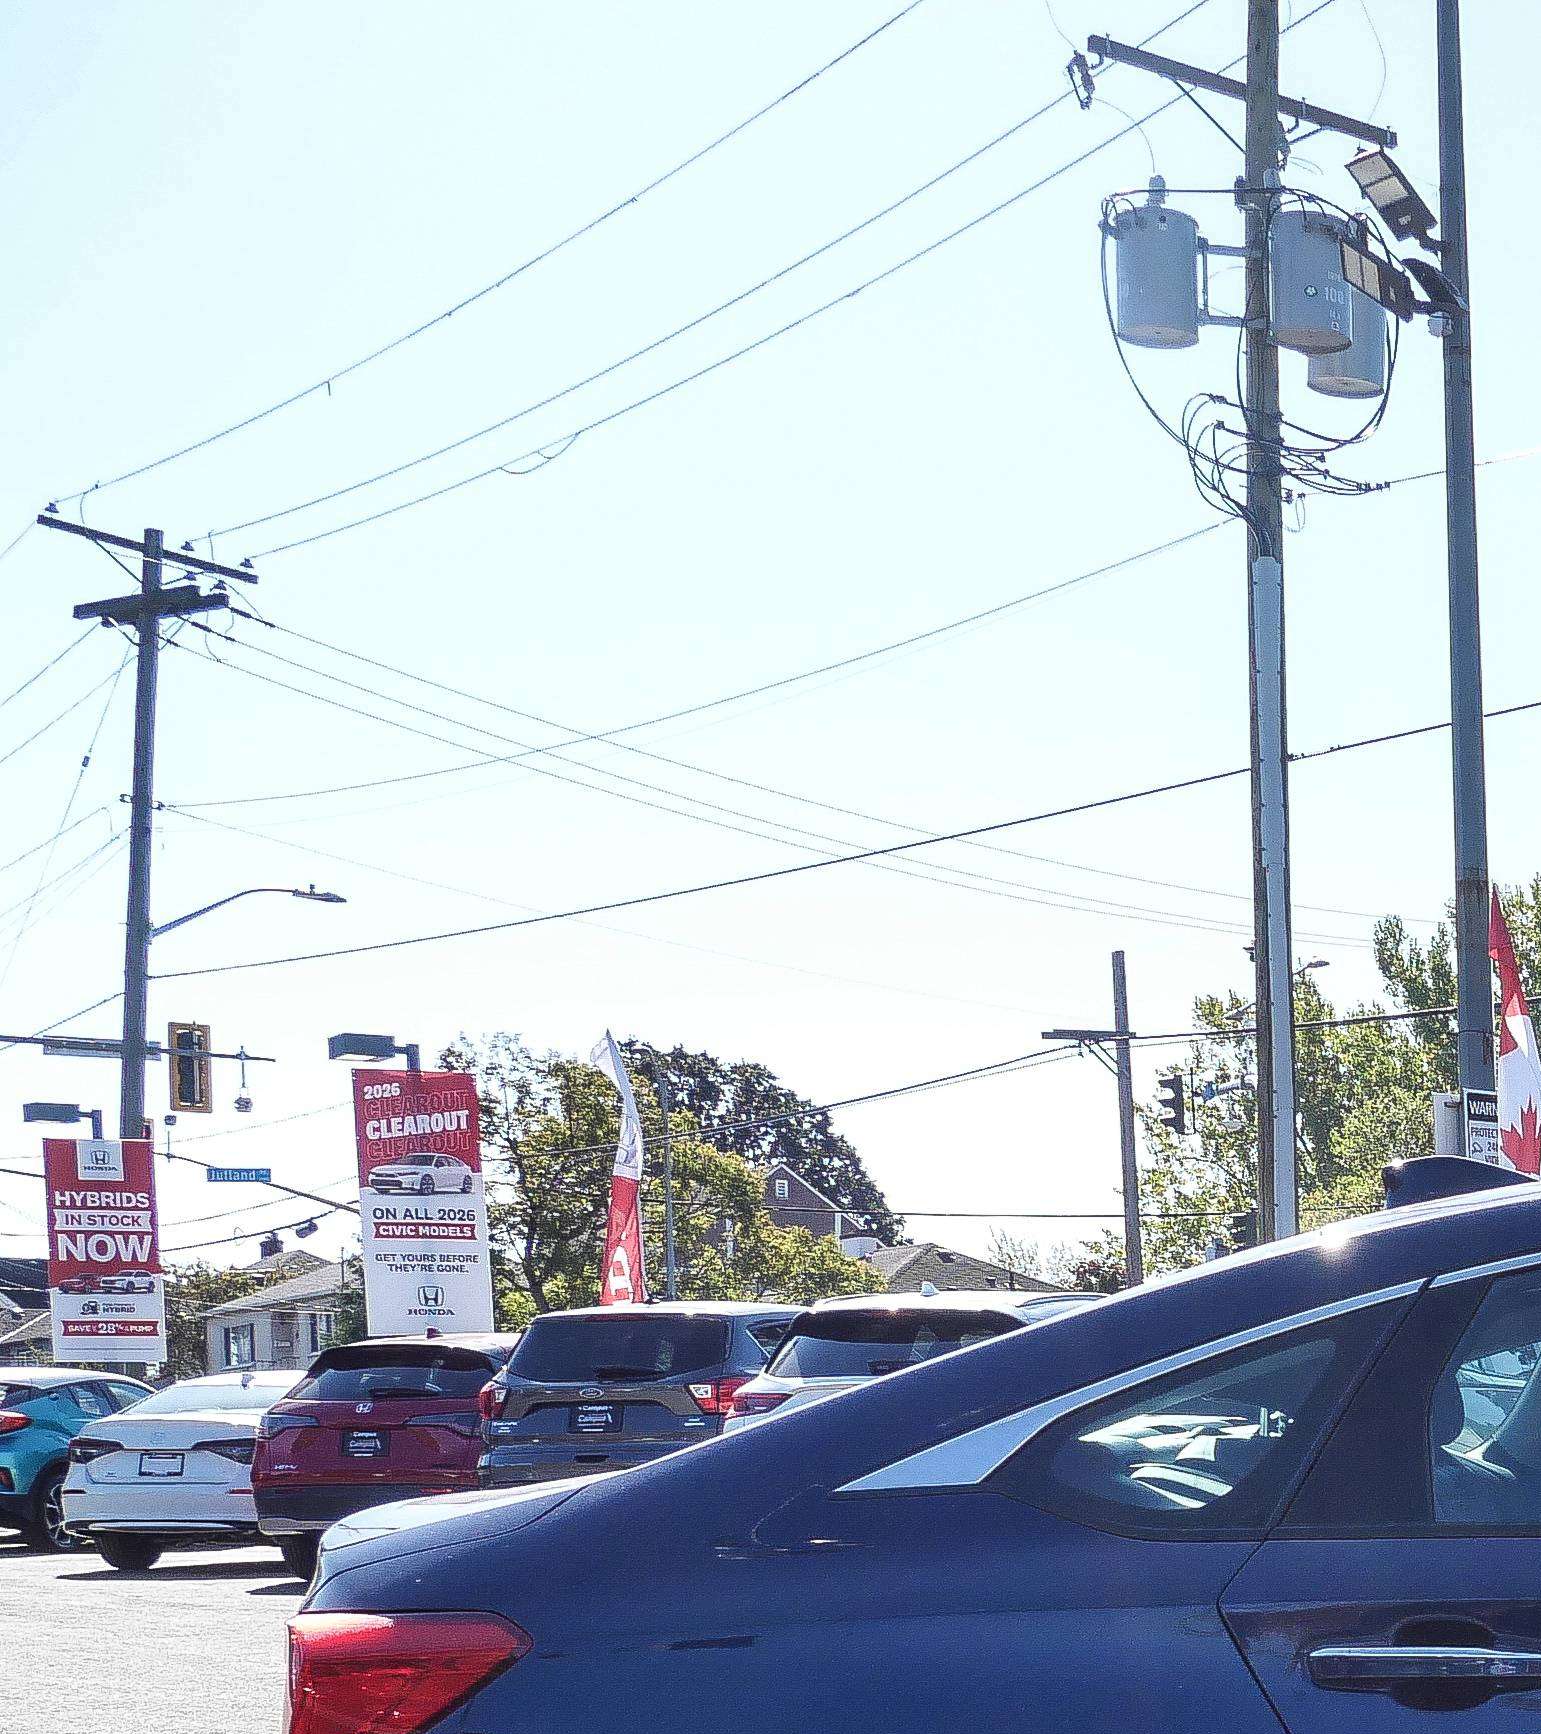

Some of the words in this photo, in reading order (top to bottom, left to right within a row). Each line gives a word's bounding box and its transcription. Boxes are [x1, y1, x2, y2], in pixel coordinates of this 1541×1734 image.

[363, 1083, 401, 1100] 2026
[366, 1110, 470, 1140] CLEAROUT
[55, 1191, 150, 1208] HYBRIDS
[65, 1214, 82, 1225] IN
[86, 1214, 142, 1227] STOCK
[372, 1207, 397, 1220] ON
[403, 1207, 433, 1220] ALL
[438, 1208, 476, 1221] 2026
[379, 1225, 416, 1236] CIVIC
[419, 1226, 472, 1237] MODELS
[57, 1233, 152, 1262] NOW
[375, 1253, 397, 1262] GET
[400, 1253, 436, 1263] YOURS
[439, 1254, 479, 1263] BEFORE
[387, 1263, 434, 1273] THEY'RE
[437, 1264, 469, 1273] GONE.
[407, 1308, 455, 1316] HONDA
